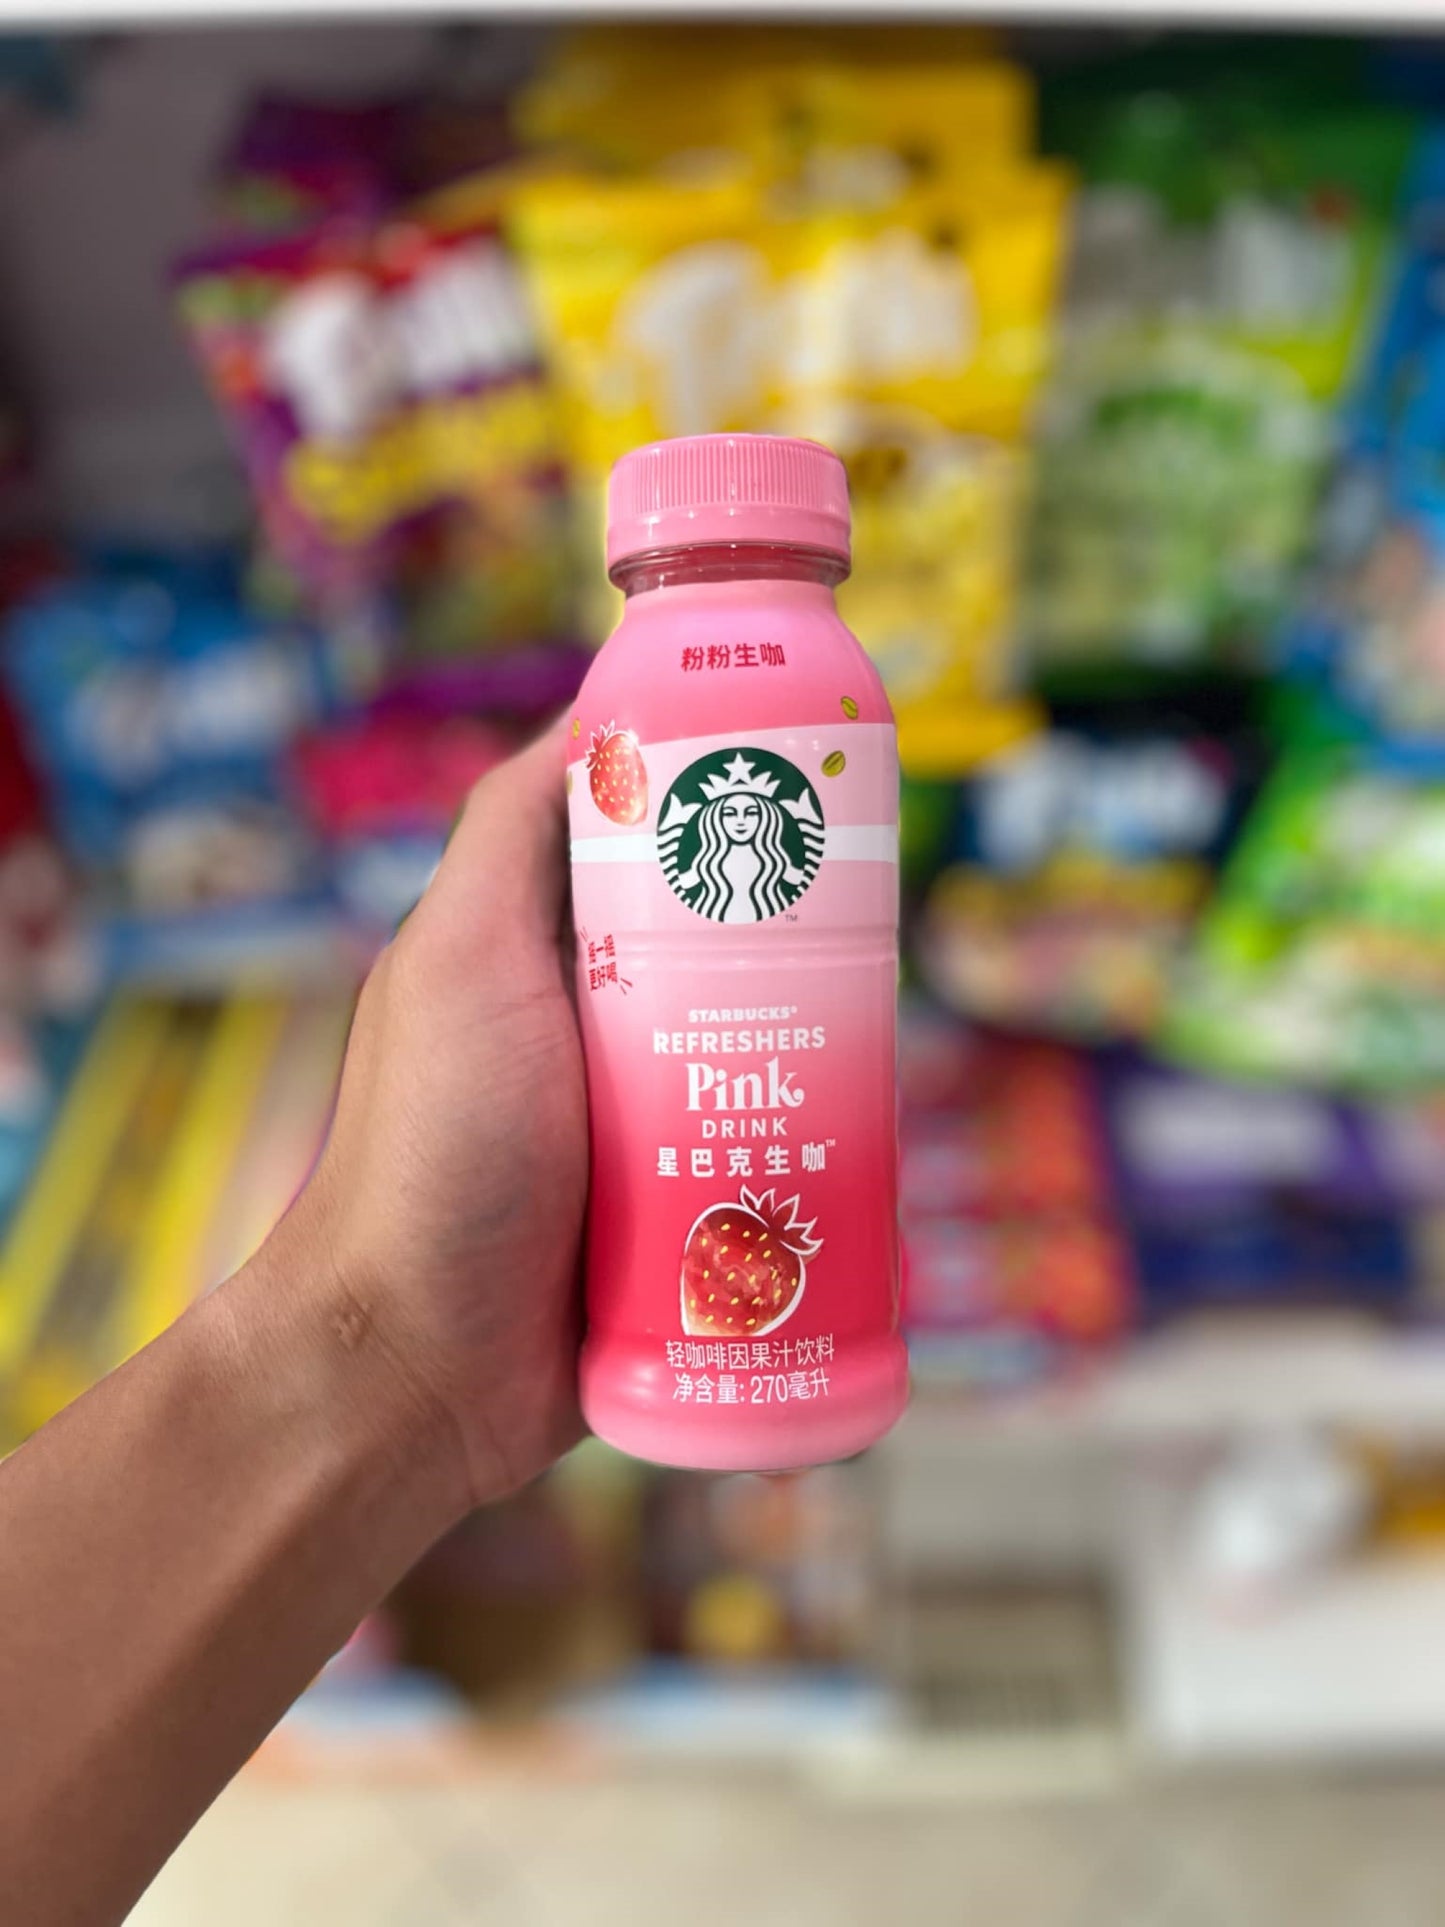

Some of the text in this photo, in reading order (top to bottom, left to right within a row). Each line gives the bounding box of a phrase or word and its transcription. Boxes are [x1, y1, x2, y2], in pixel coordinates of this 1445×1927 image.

[681, 642, 786, 672] 粉粉生咖
[653, 1026, 826, 1054] REFRESHERS
[685, 1056, 805, 1111] Pink
[702, 1117, 788, 1139] DRINK
[666, 1333, 835, 1371] 轻咖啡因果汁饮料
[672, 1367, 830, 1404] 净含量: 270毫升
